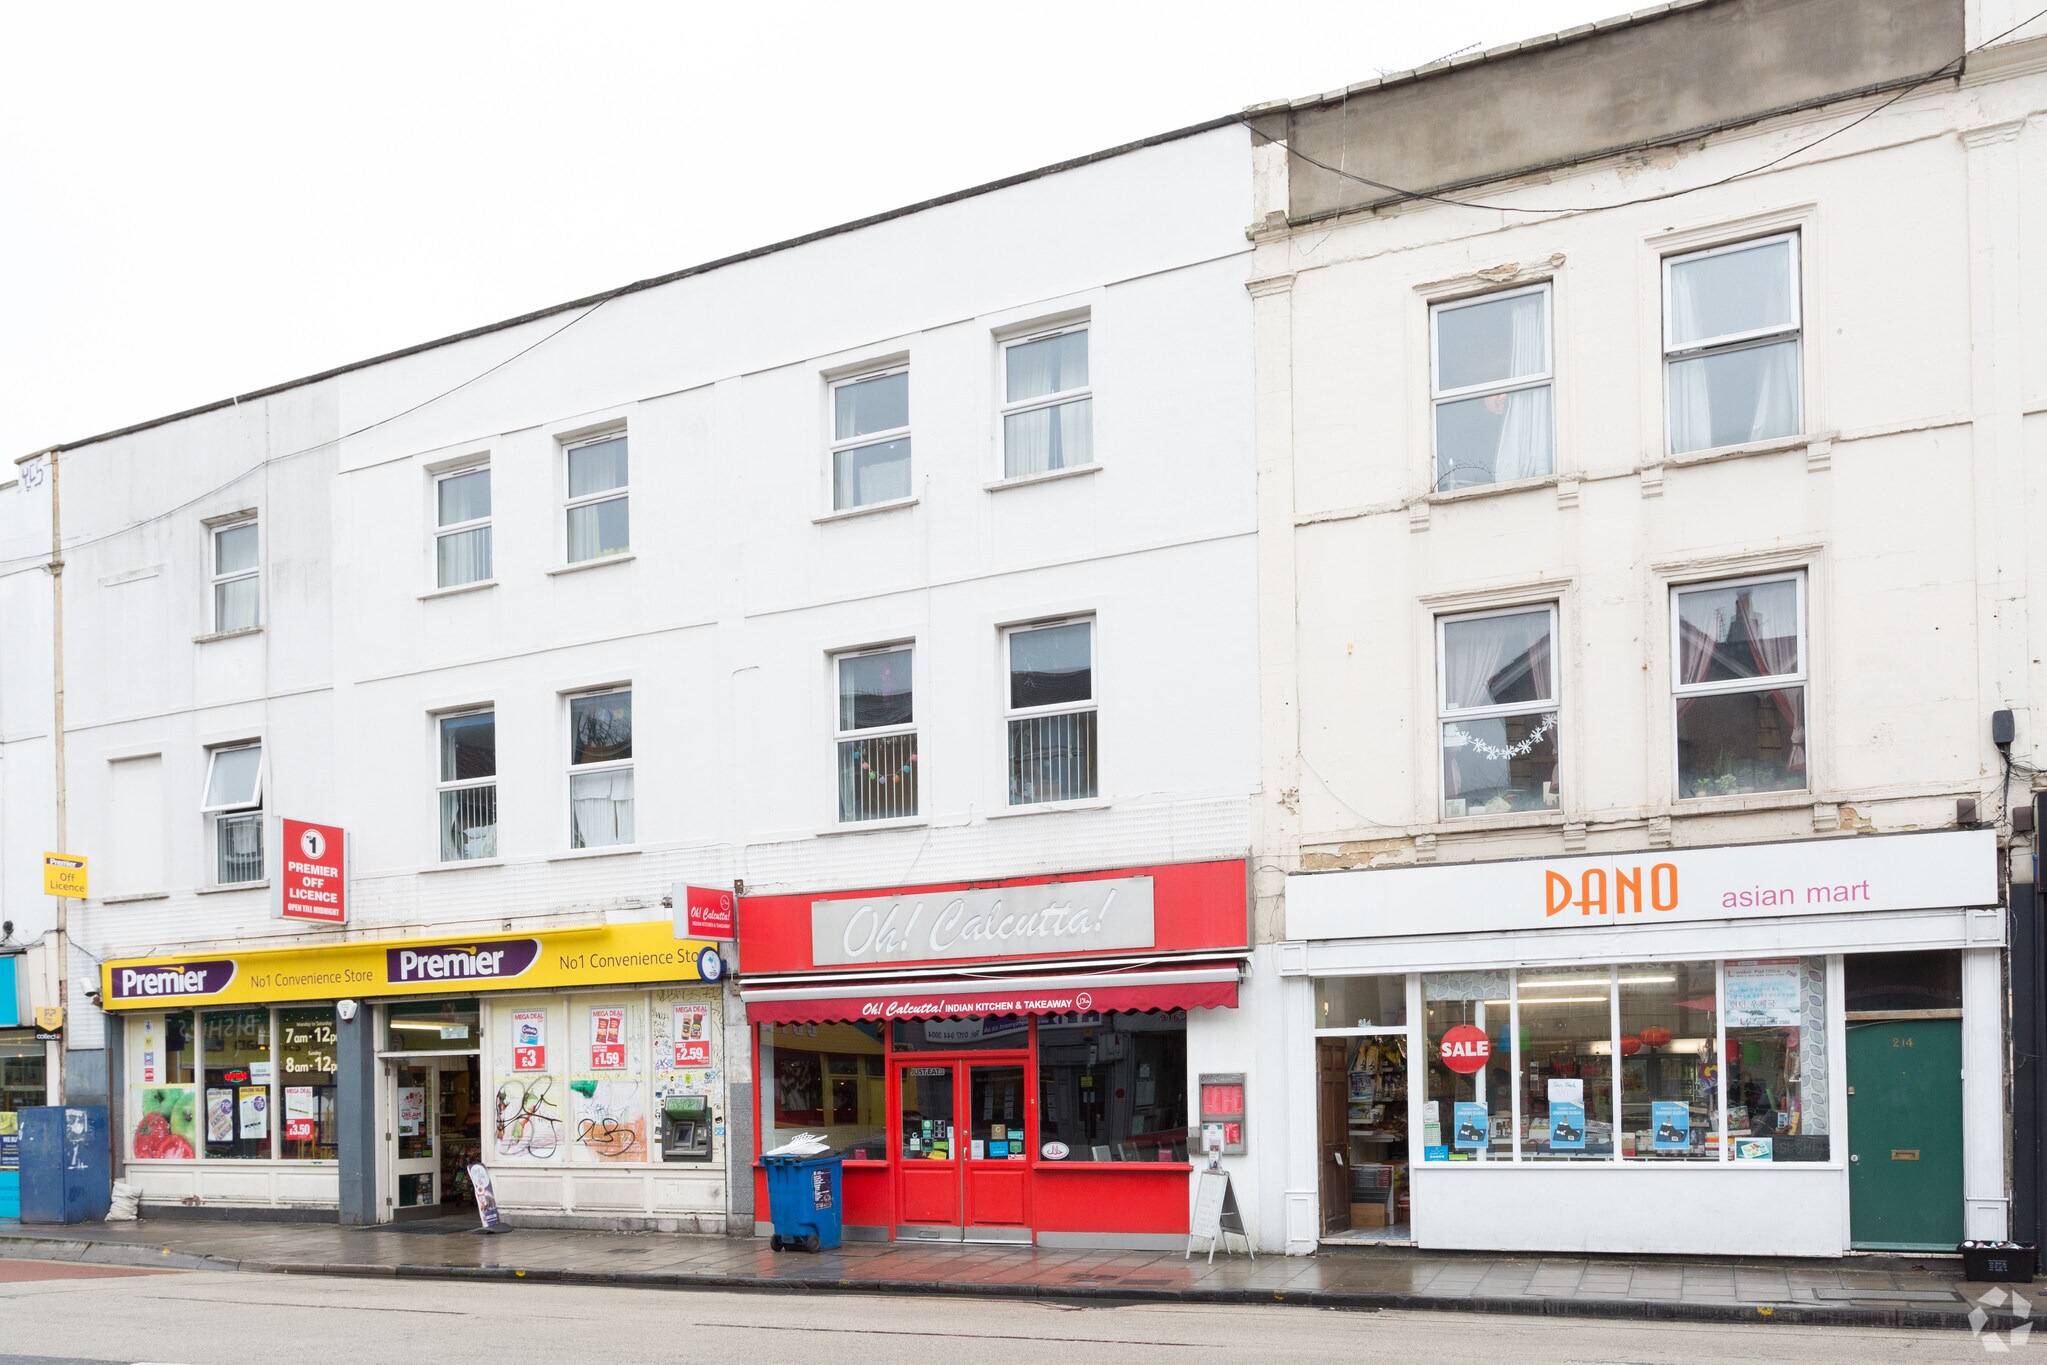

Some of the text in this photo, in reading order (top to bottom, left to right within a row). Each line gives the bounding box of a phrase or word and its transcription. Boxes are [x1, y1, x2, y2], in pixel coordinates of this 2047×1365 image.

[50, 858, 77, 868] Premier
[288, 861, 339, 877] PREMIER
[60, 872, 75, 882] Off
[302, 877, 325, 889] OFF
[50, 881, 85, 892] Licence
[1545, 862, 1679, 918] DANO
[1721, 880, 1870, 909] asian mart
[289, 887, 338, 903] LICENCE
[287, 902, 340, 917] OPEN TILL MIDNIGHT
[690, 906, 731, 921] Oh! Calcutta!
[843, 888, 1118, 957] Oh! Calcutta!
[400, 947, 505, 981] Premier
[559, 948, 699, 970] No1 Convenience Sto
[122, 967, 208, 997] Premier
[250, 969, 373, 988] No1 Convenience Store
[862, 999, 1073, 1017] Oh! Calcutta! INDIAN KITCHEN & TAKEAWAY
[314, 1026, 338, 1045] 12p
[1892, 1037, 1914, 1048] 214
[676, 1047, 703, 1060] £2.59
[1441, 1041, 1489, 1057] SALE
[314, 1056, 338, 1075] 12p
[522, 1049, 536, 1067] £3
[595, 1052, 619, 1065] £1.59
[224, 1071, 248, 1081] OPEN
[911, 1068, 926, 1076] JUST
[289, 1124, 310, 1136] £3.50
